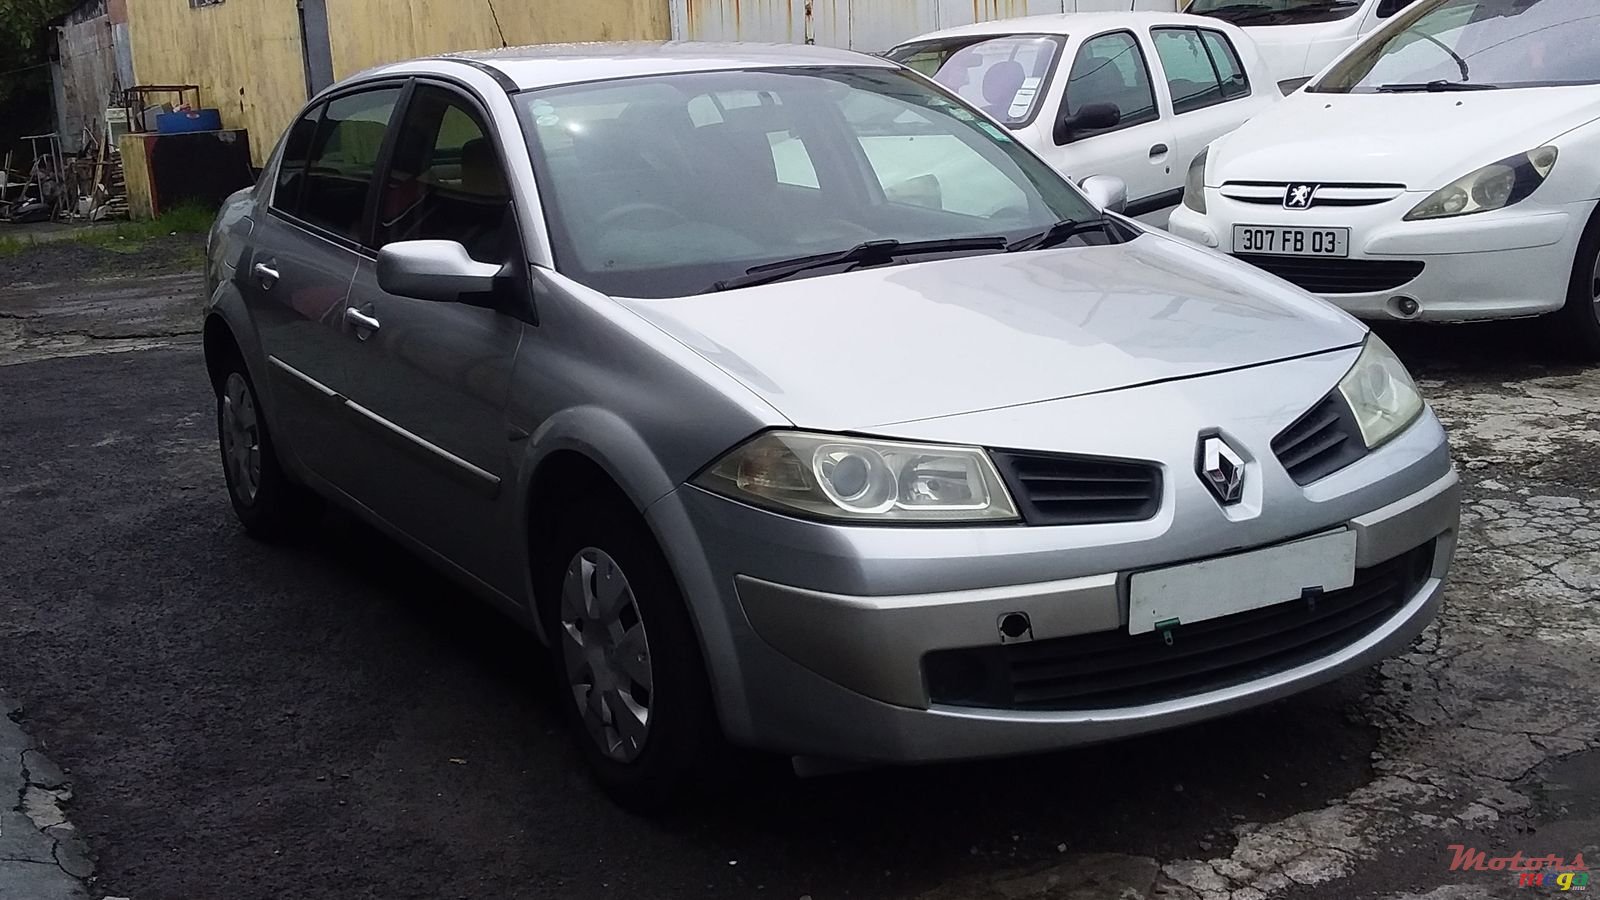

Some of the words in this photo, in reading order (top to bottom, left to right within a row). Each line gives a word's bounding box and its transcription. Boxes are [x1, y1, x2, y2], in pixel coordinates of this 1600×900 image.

[1244, 230, 1274, 251] 307
[1282, 230, 1304, 252] FB
[1312, 231, 1336, 253] 03
